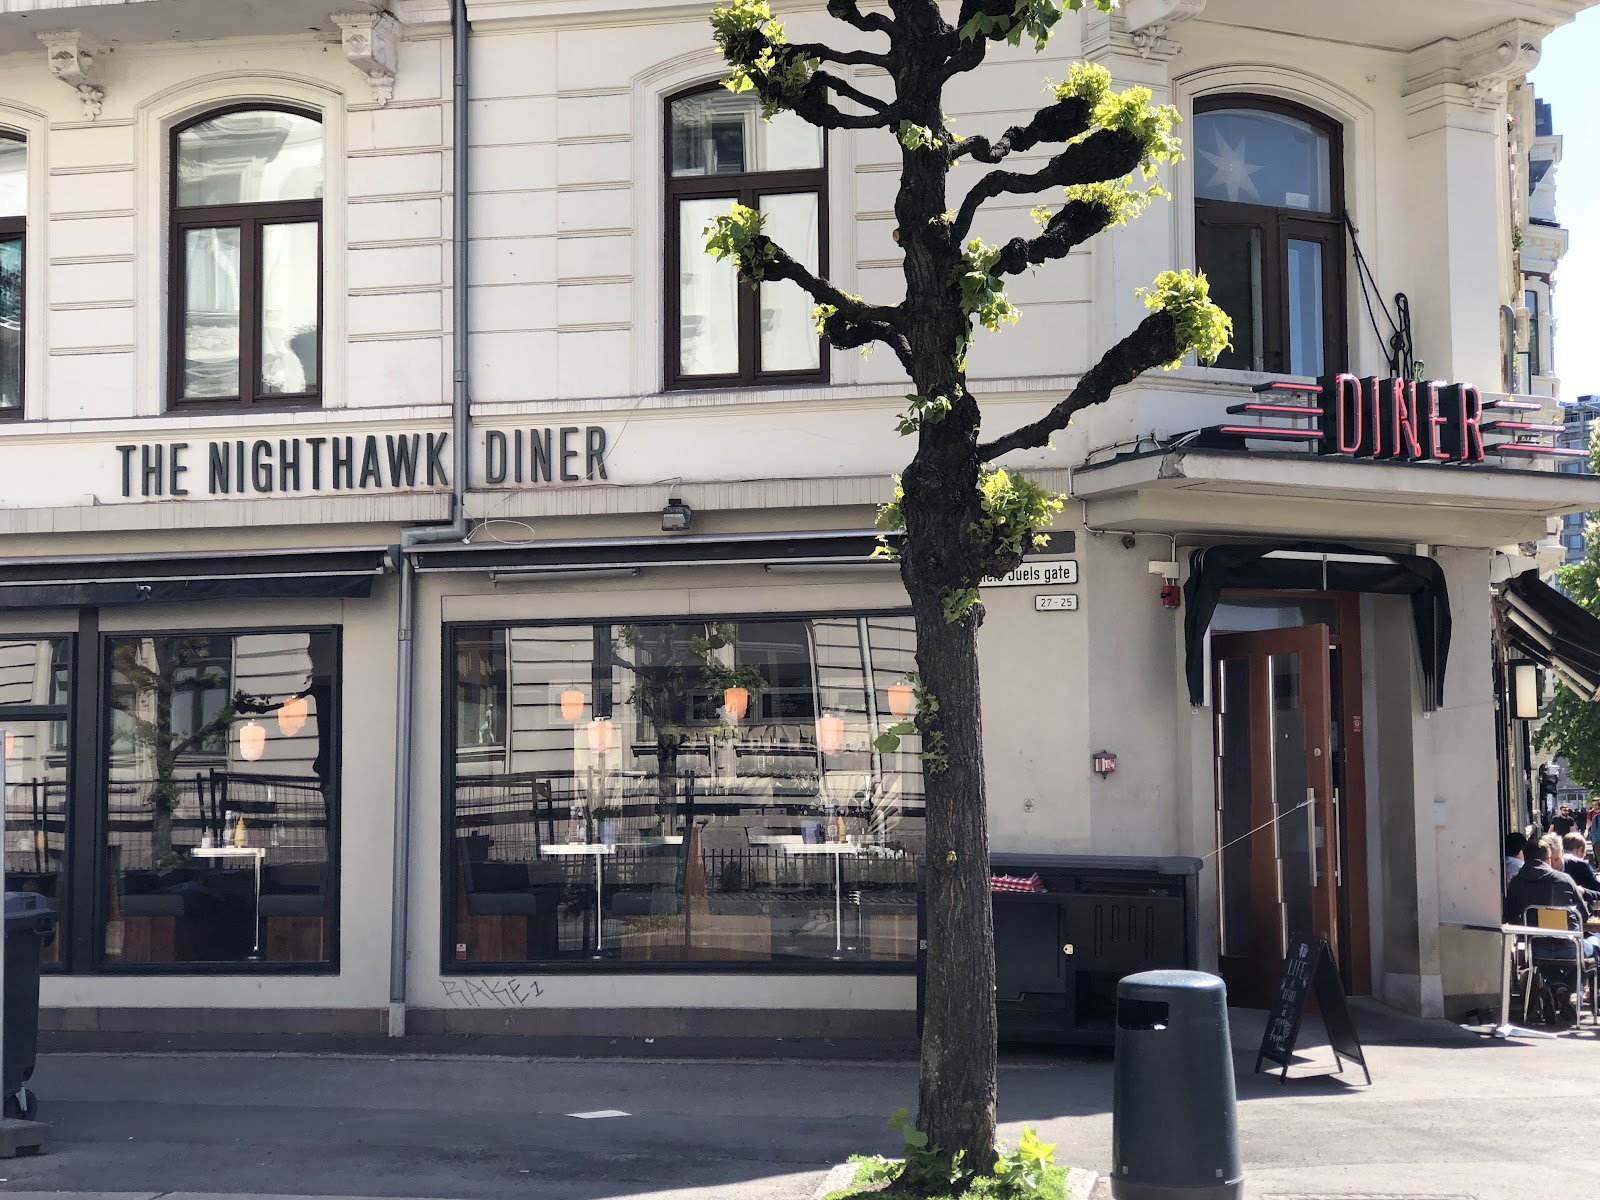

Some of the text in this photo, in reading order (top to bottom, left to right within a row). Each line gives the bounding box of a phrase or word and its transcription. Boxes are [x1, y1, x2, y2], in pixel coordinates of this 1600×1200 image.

[1335, 372, 1485, 463] DINER
[115, 425, 608, 498] THE NIGHTHAWK DINER
[1008, 565, 1040, 582] Juels
[1044, 564, 1070, 584] gate
